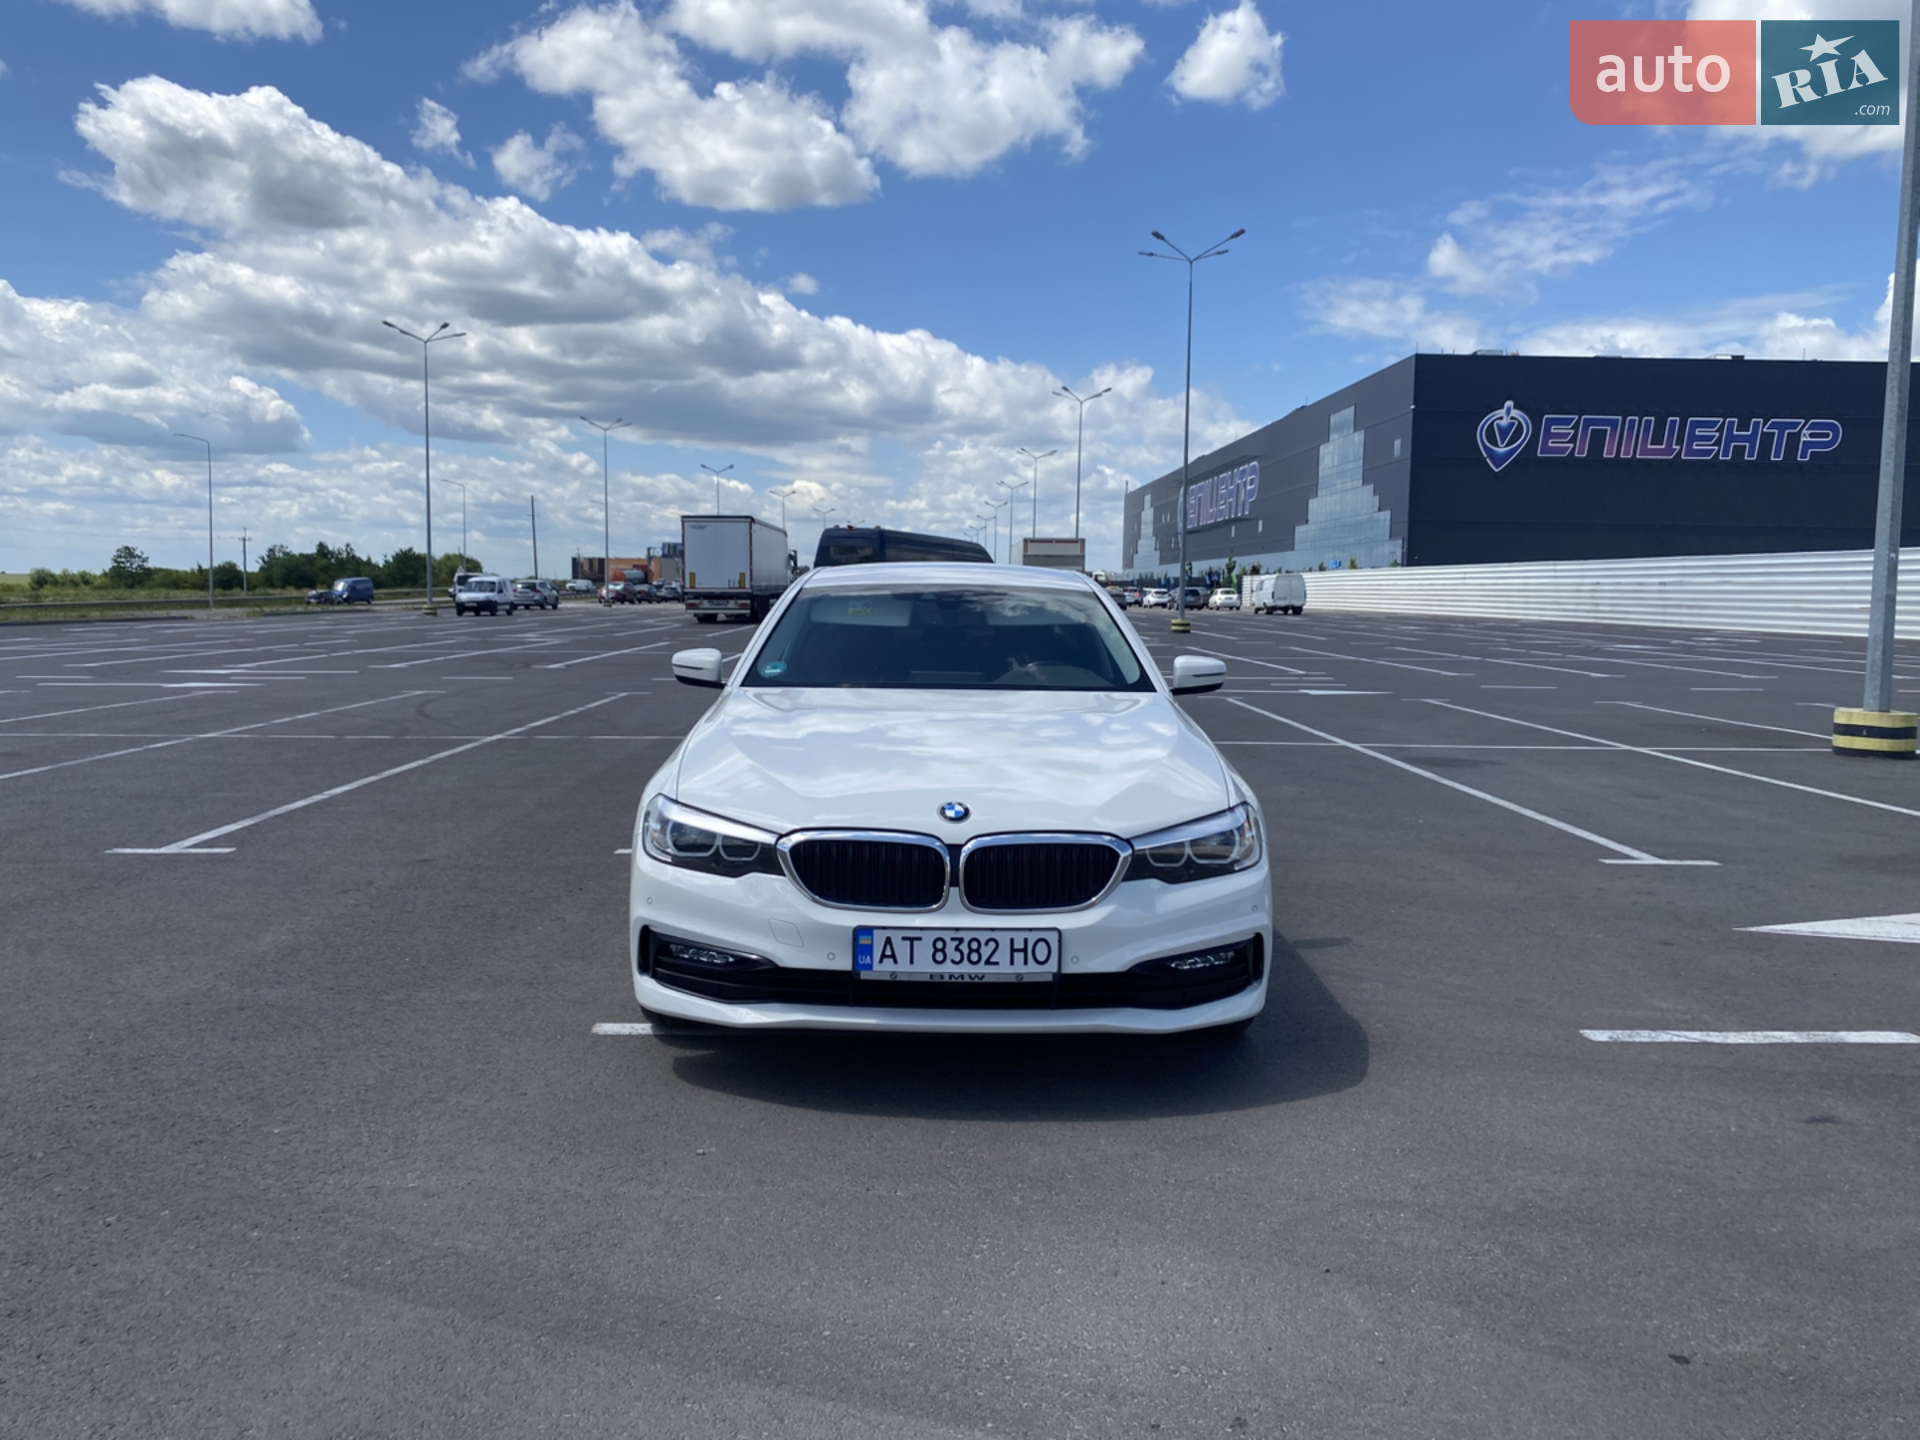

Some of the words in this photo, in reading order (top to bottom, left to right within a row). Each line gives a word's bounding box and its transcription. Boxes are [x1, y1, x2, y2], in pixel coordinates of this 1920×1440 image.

[1537, 414, 1843, 461] ЕПІЦЕНТР
[858, 955, 872, 965] UA
[878, 936, 922, 965] AT
[931, 937, 1000, 966] 8382
[1009, 937, 1052, 966] HO
[929, 973, 987, 981] BMW
